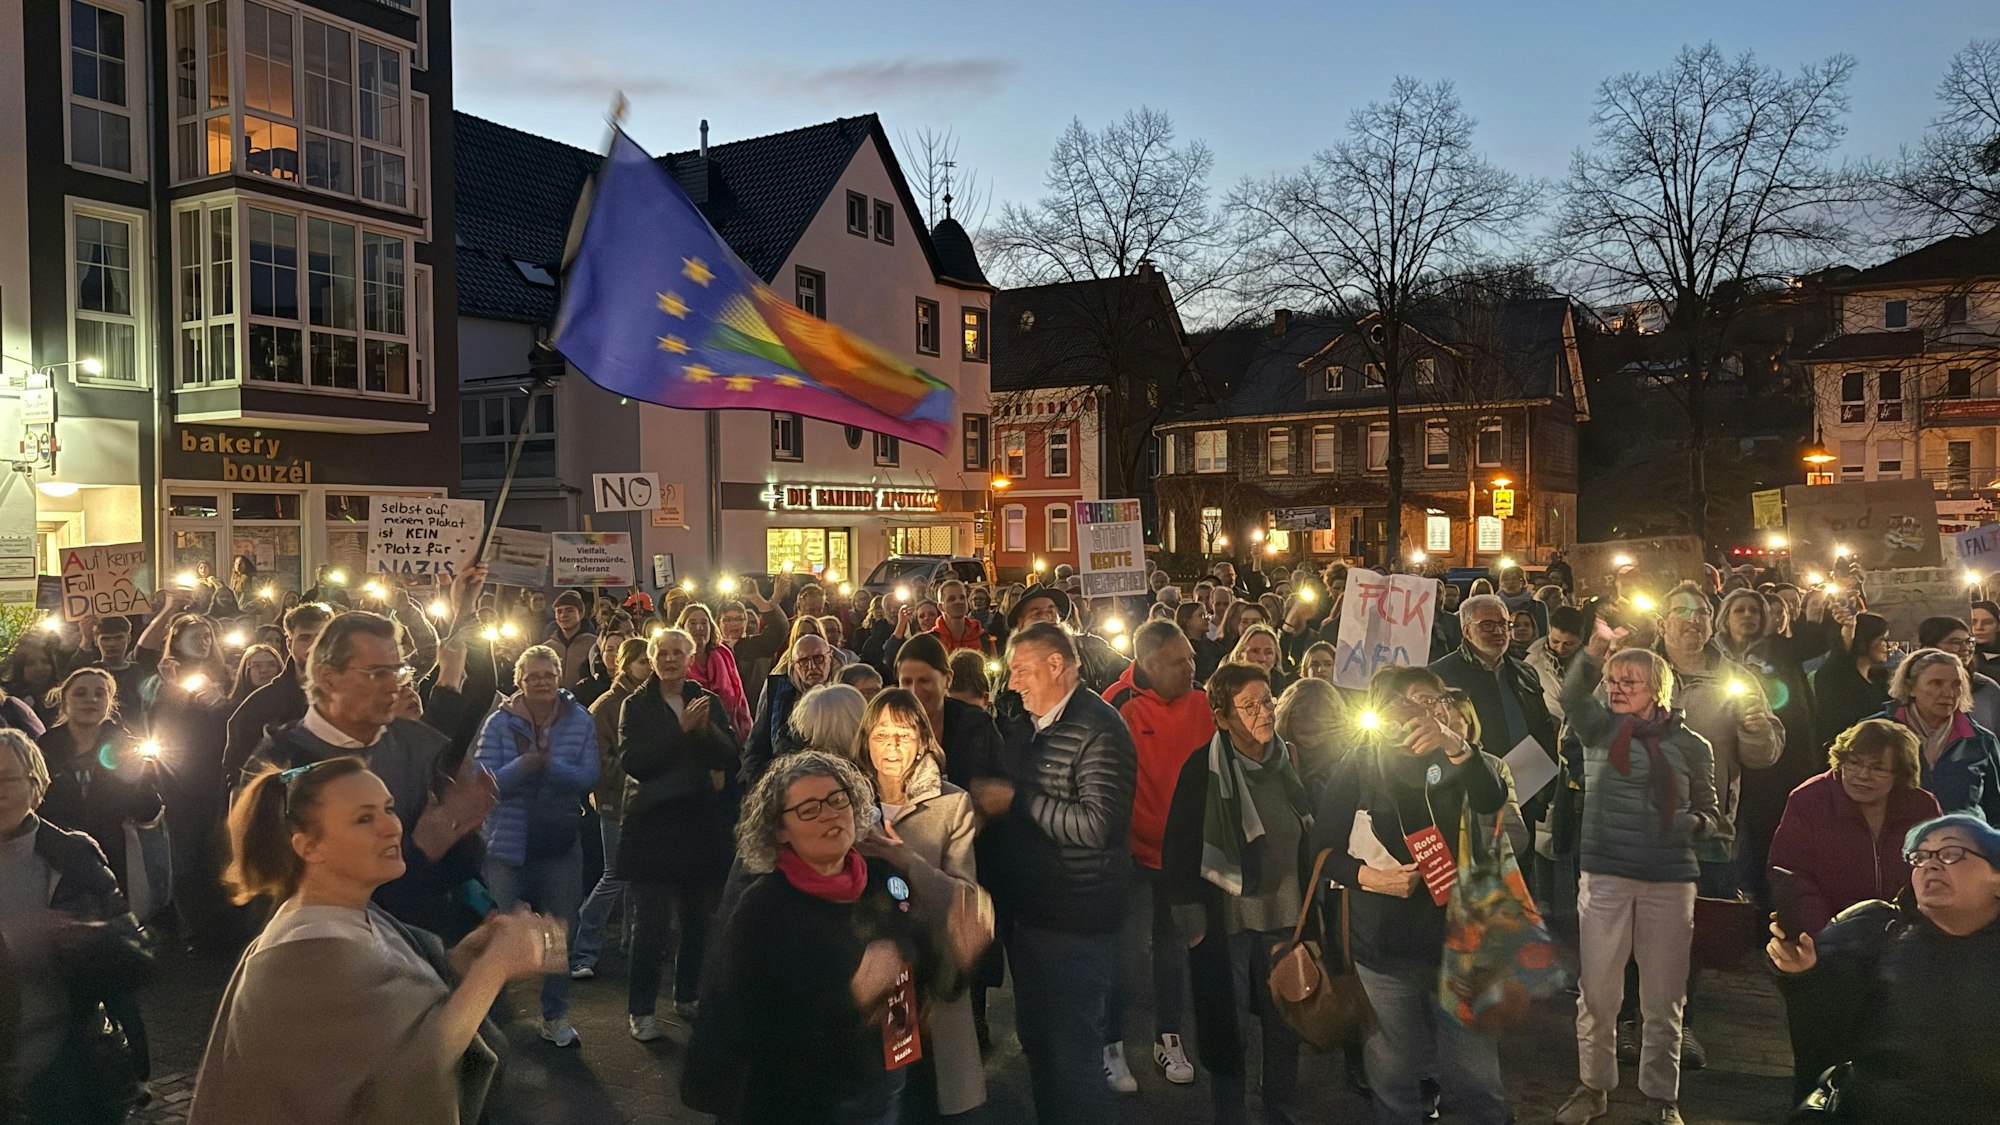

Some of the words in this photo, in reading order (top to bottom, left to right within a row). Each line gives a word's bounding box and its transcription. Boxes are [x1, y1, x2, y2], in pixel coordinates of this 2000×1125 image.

[182, 430, 280, 459] bakery
[223, 457, 311, 483] bouzél
[786, 487, 811, 506] DIE
[425, 504, 449, 517] auf
[384, 516, 423, 526] meinem
[428, 517, 466, 528] Plakat
[378, 528, 394, 538] ist
[405, 528, 438, 539] KEIN
[384, 542, 421, 554] Platz
[425, 542, 451, 556] für
[576, 547, 607, 555] Vielfalt,
[64, 549, 102, 574] Auf
[379, 559, 457, 580] NAZIS
[559, 556, 626, 564] Menschenwürde,
[64, 573, 96, 594] Fall
[67, 588, 152, 618] DIGGA
[1358, 583, 1431, 636] FCK
[1413, 834, 1437, 852] Rote
[1415, 842, 1444, 863] Karte
